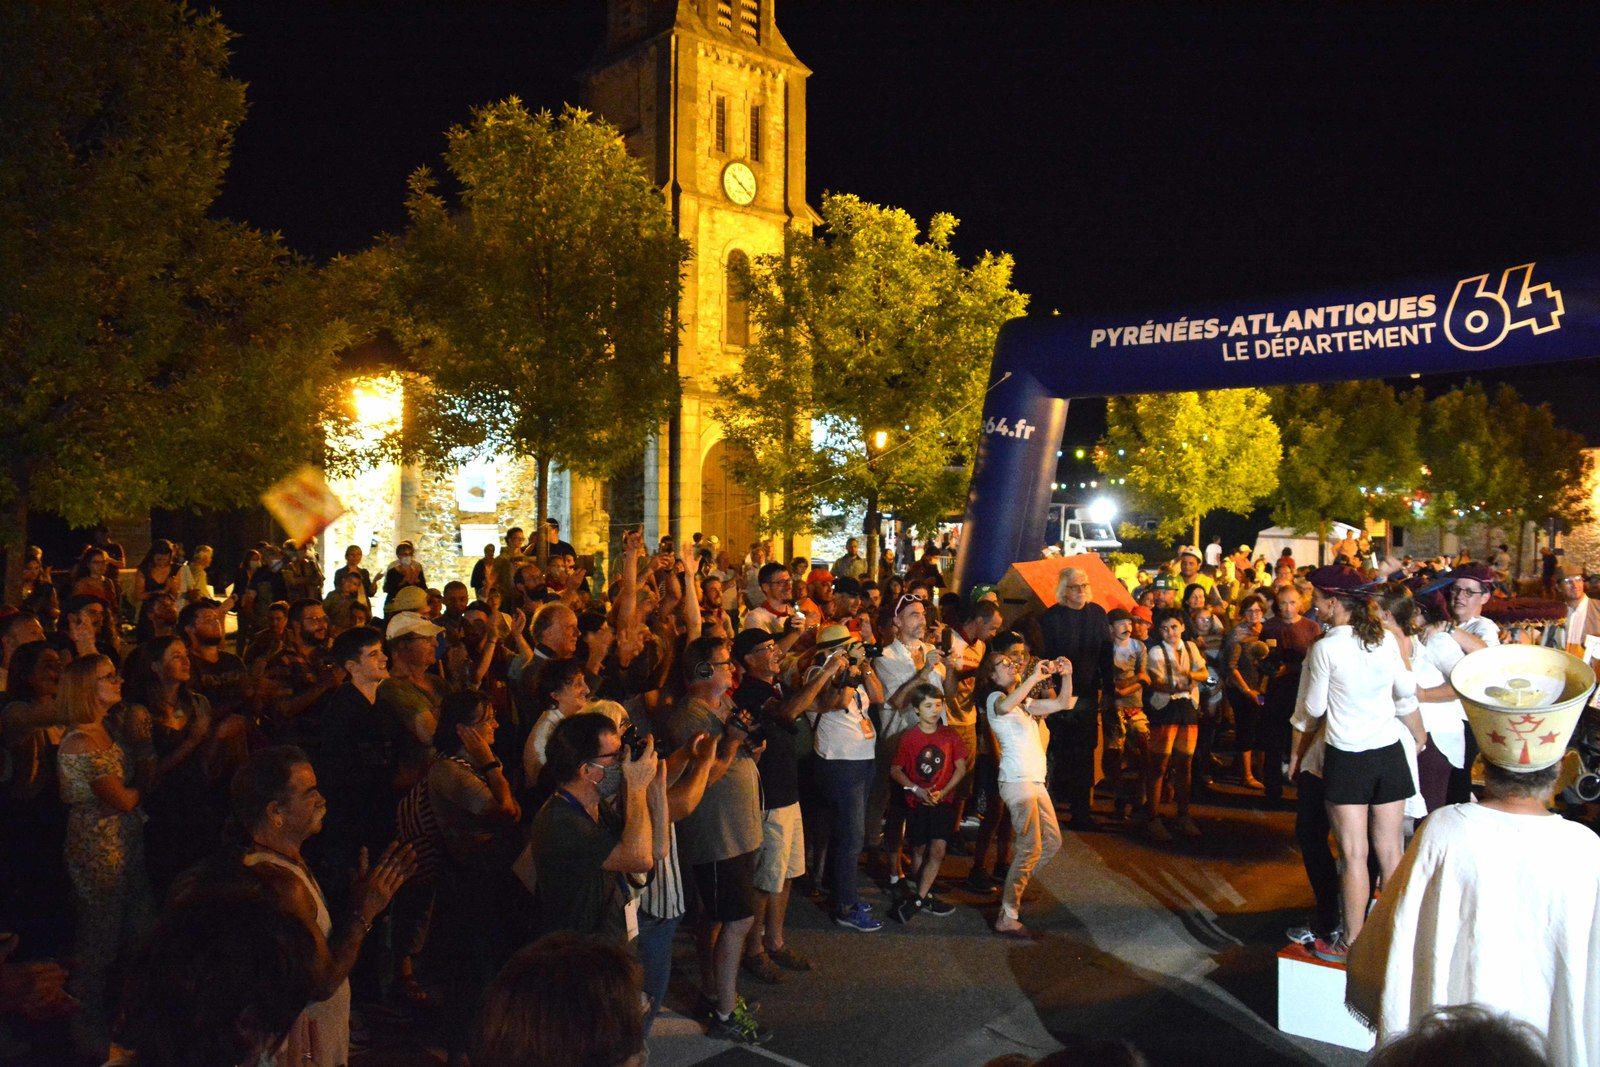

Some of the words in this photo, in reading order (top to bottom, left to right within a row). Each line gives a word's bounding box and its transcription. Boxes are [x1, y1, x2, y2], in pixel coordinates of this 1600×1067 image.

[1090, 294, 1437, 348] PYRÉNÉES-ATLANTIQUES
[1443, 261, 1566, 352] 64
[1222, 341, 1250, 362] LE
[1254, 322, 1437, 360] DÉPARTEMENT
